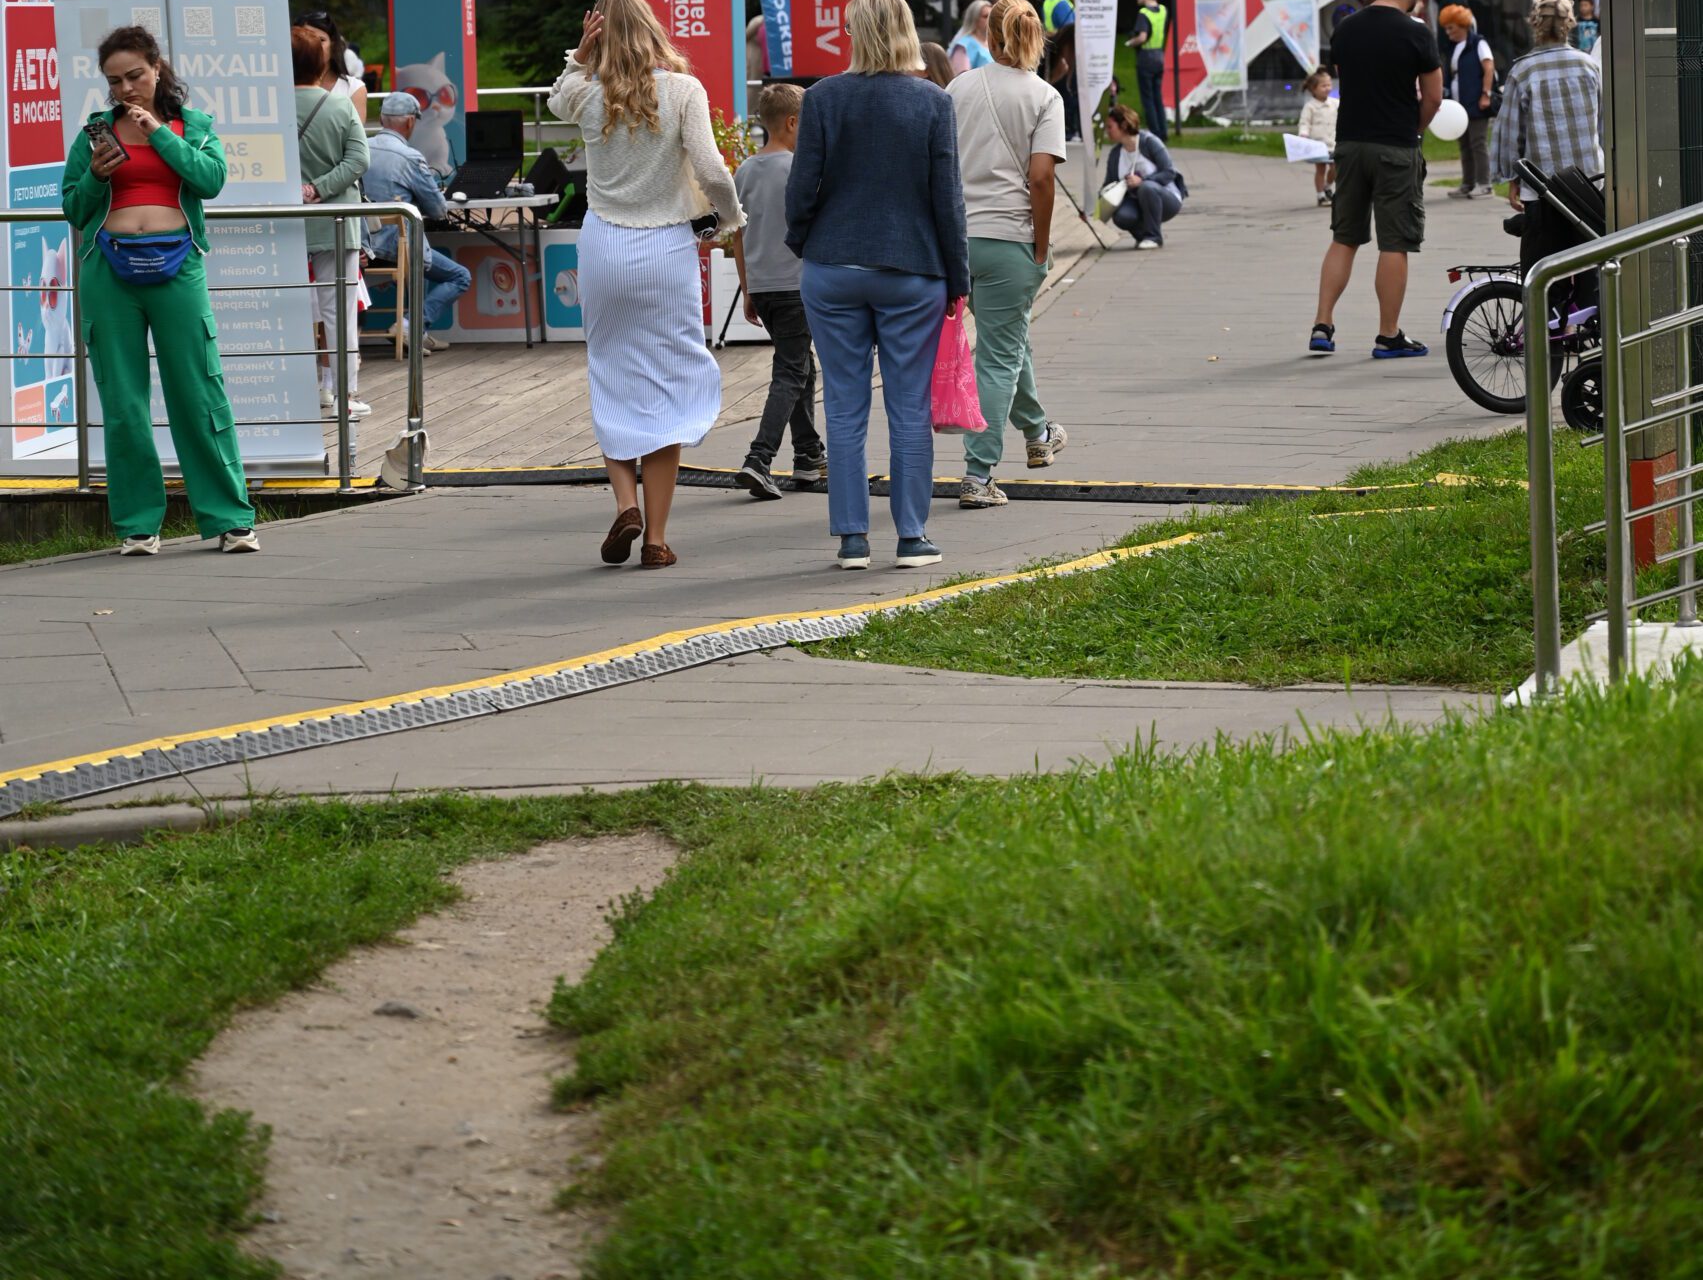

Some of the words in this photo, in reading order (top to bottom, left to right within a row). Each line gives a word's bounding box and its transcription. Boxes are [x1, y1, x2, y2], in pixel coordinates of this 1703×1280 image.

[13, 47, 59, 91] ЛЕТО
[13, 103, 21, 125] В
[23, 99, 61, 124] МОСКВЕ
